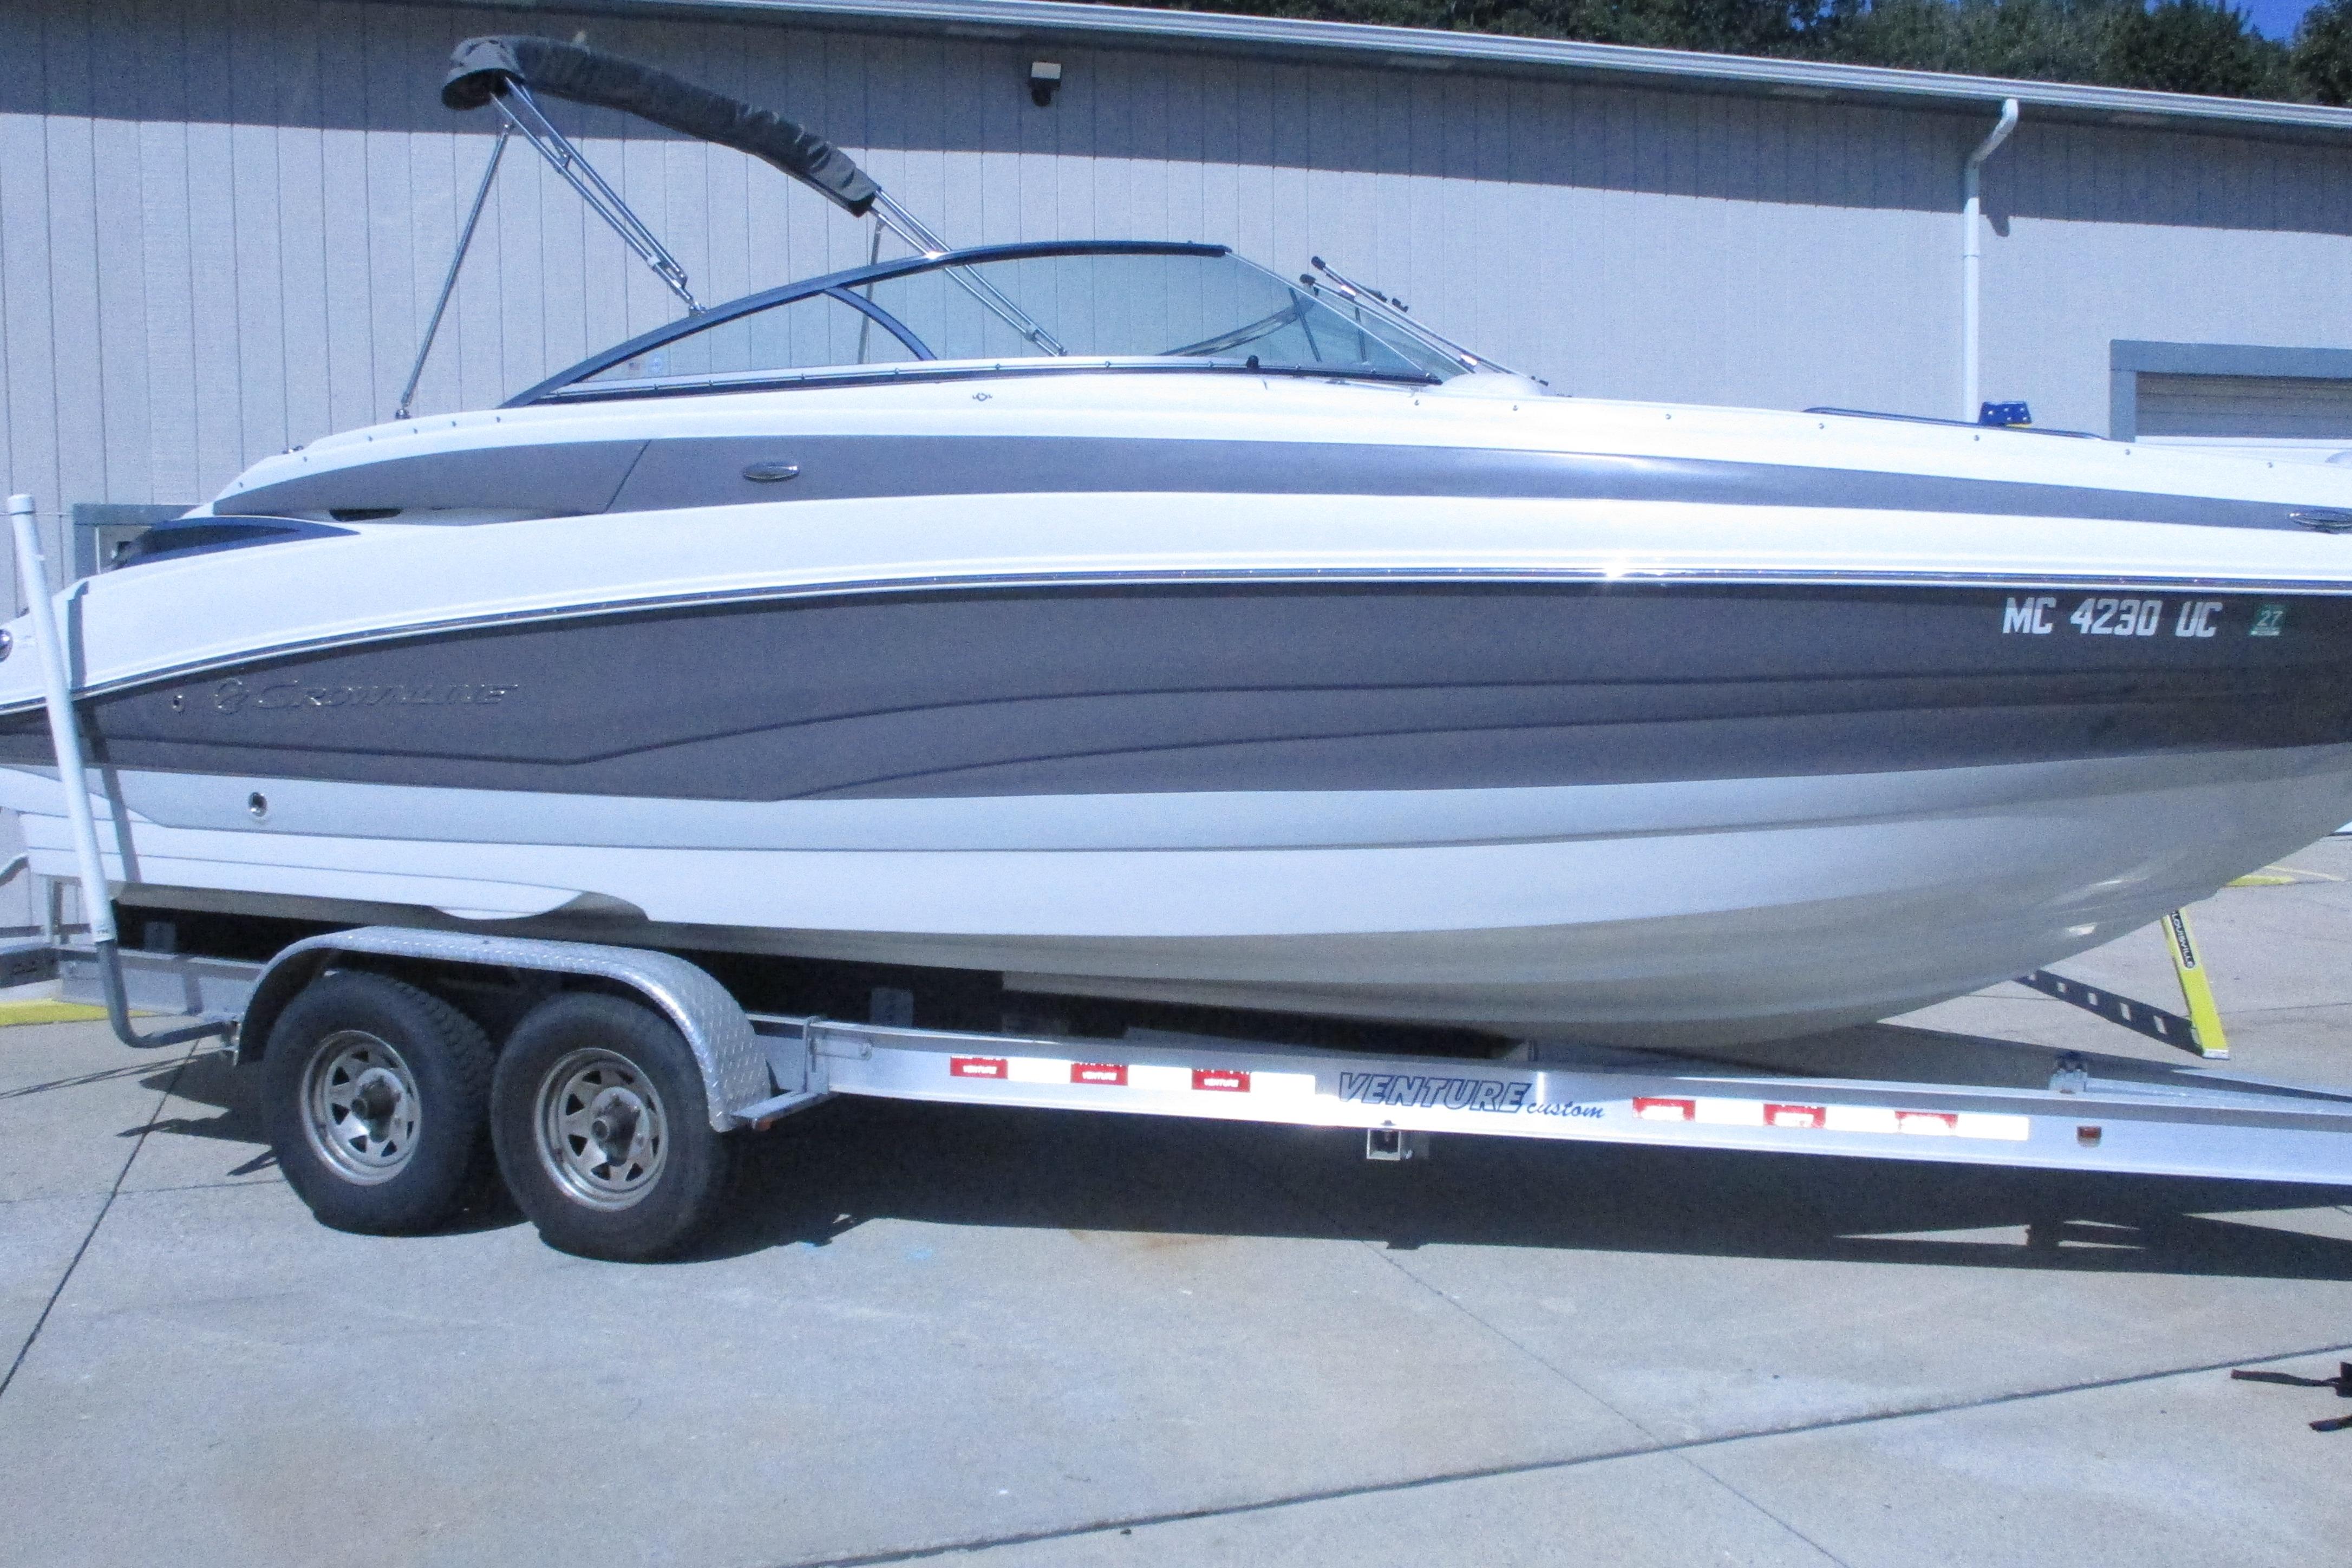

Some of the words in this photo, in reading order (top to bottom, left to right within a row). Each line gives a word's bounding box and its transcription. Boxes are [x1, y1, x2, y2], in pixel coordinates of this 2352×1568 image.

[2003, 597, 2057, 635] MC
[2070, 597, 2162, 636] 4230
[2175, 601, 2223, 637] UC
[1339, 1072, 1532, 1113] VENTURE
[1526, 1101, 1606, 1119] custom
